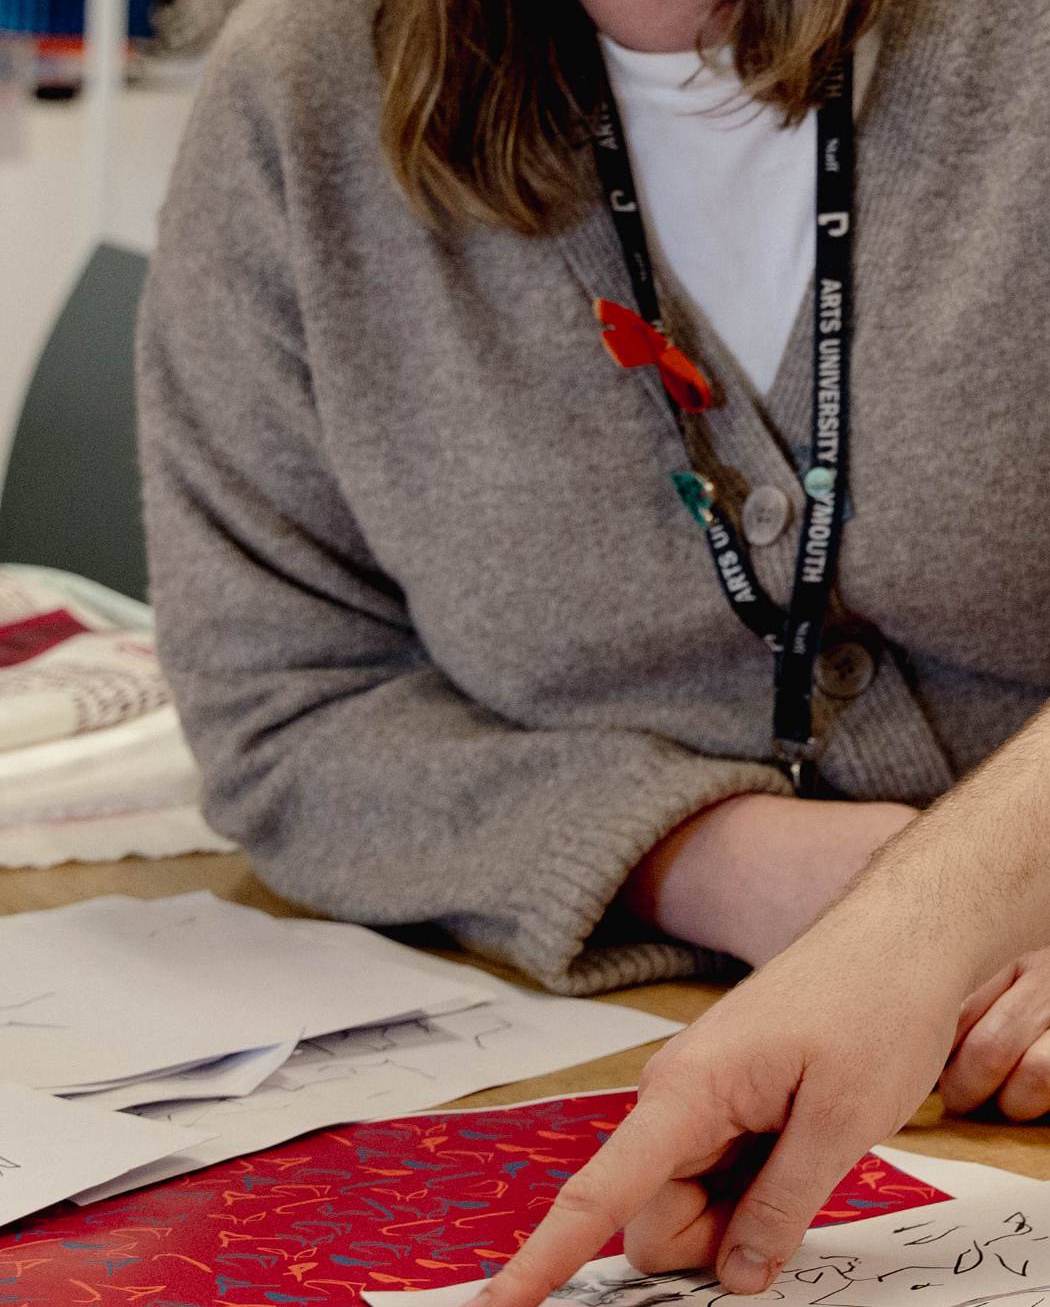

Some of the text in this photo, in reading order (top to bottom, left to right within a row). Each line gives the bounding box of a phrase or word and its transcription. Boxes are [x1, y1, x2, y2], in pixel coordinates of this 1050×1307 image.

[819, 278, 842, 334] ARTS
[817, 338, 842, 463] UNIVERSITY
[717, 548, 757, 603] ARTS
